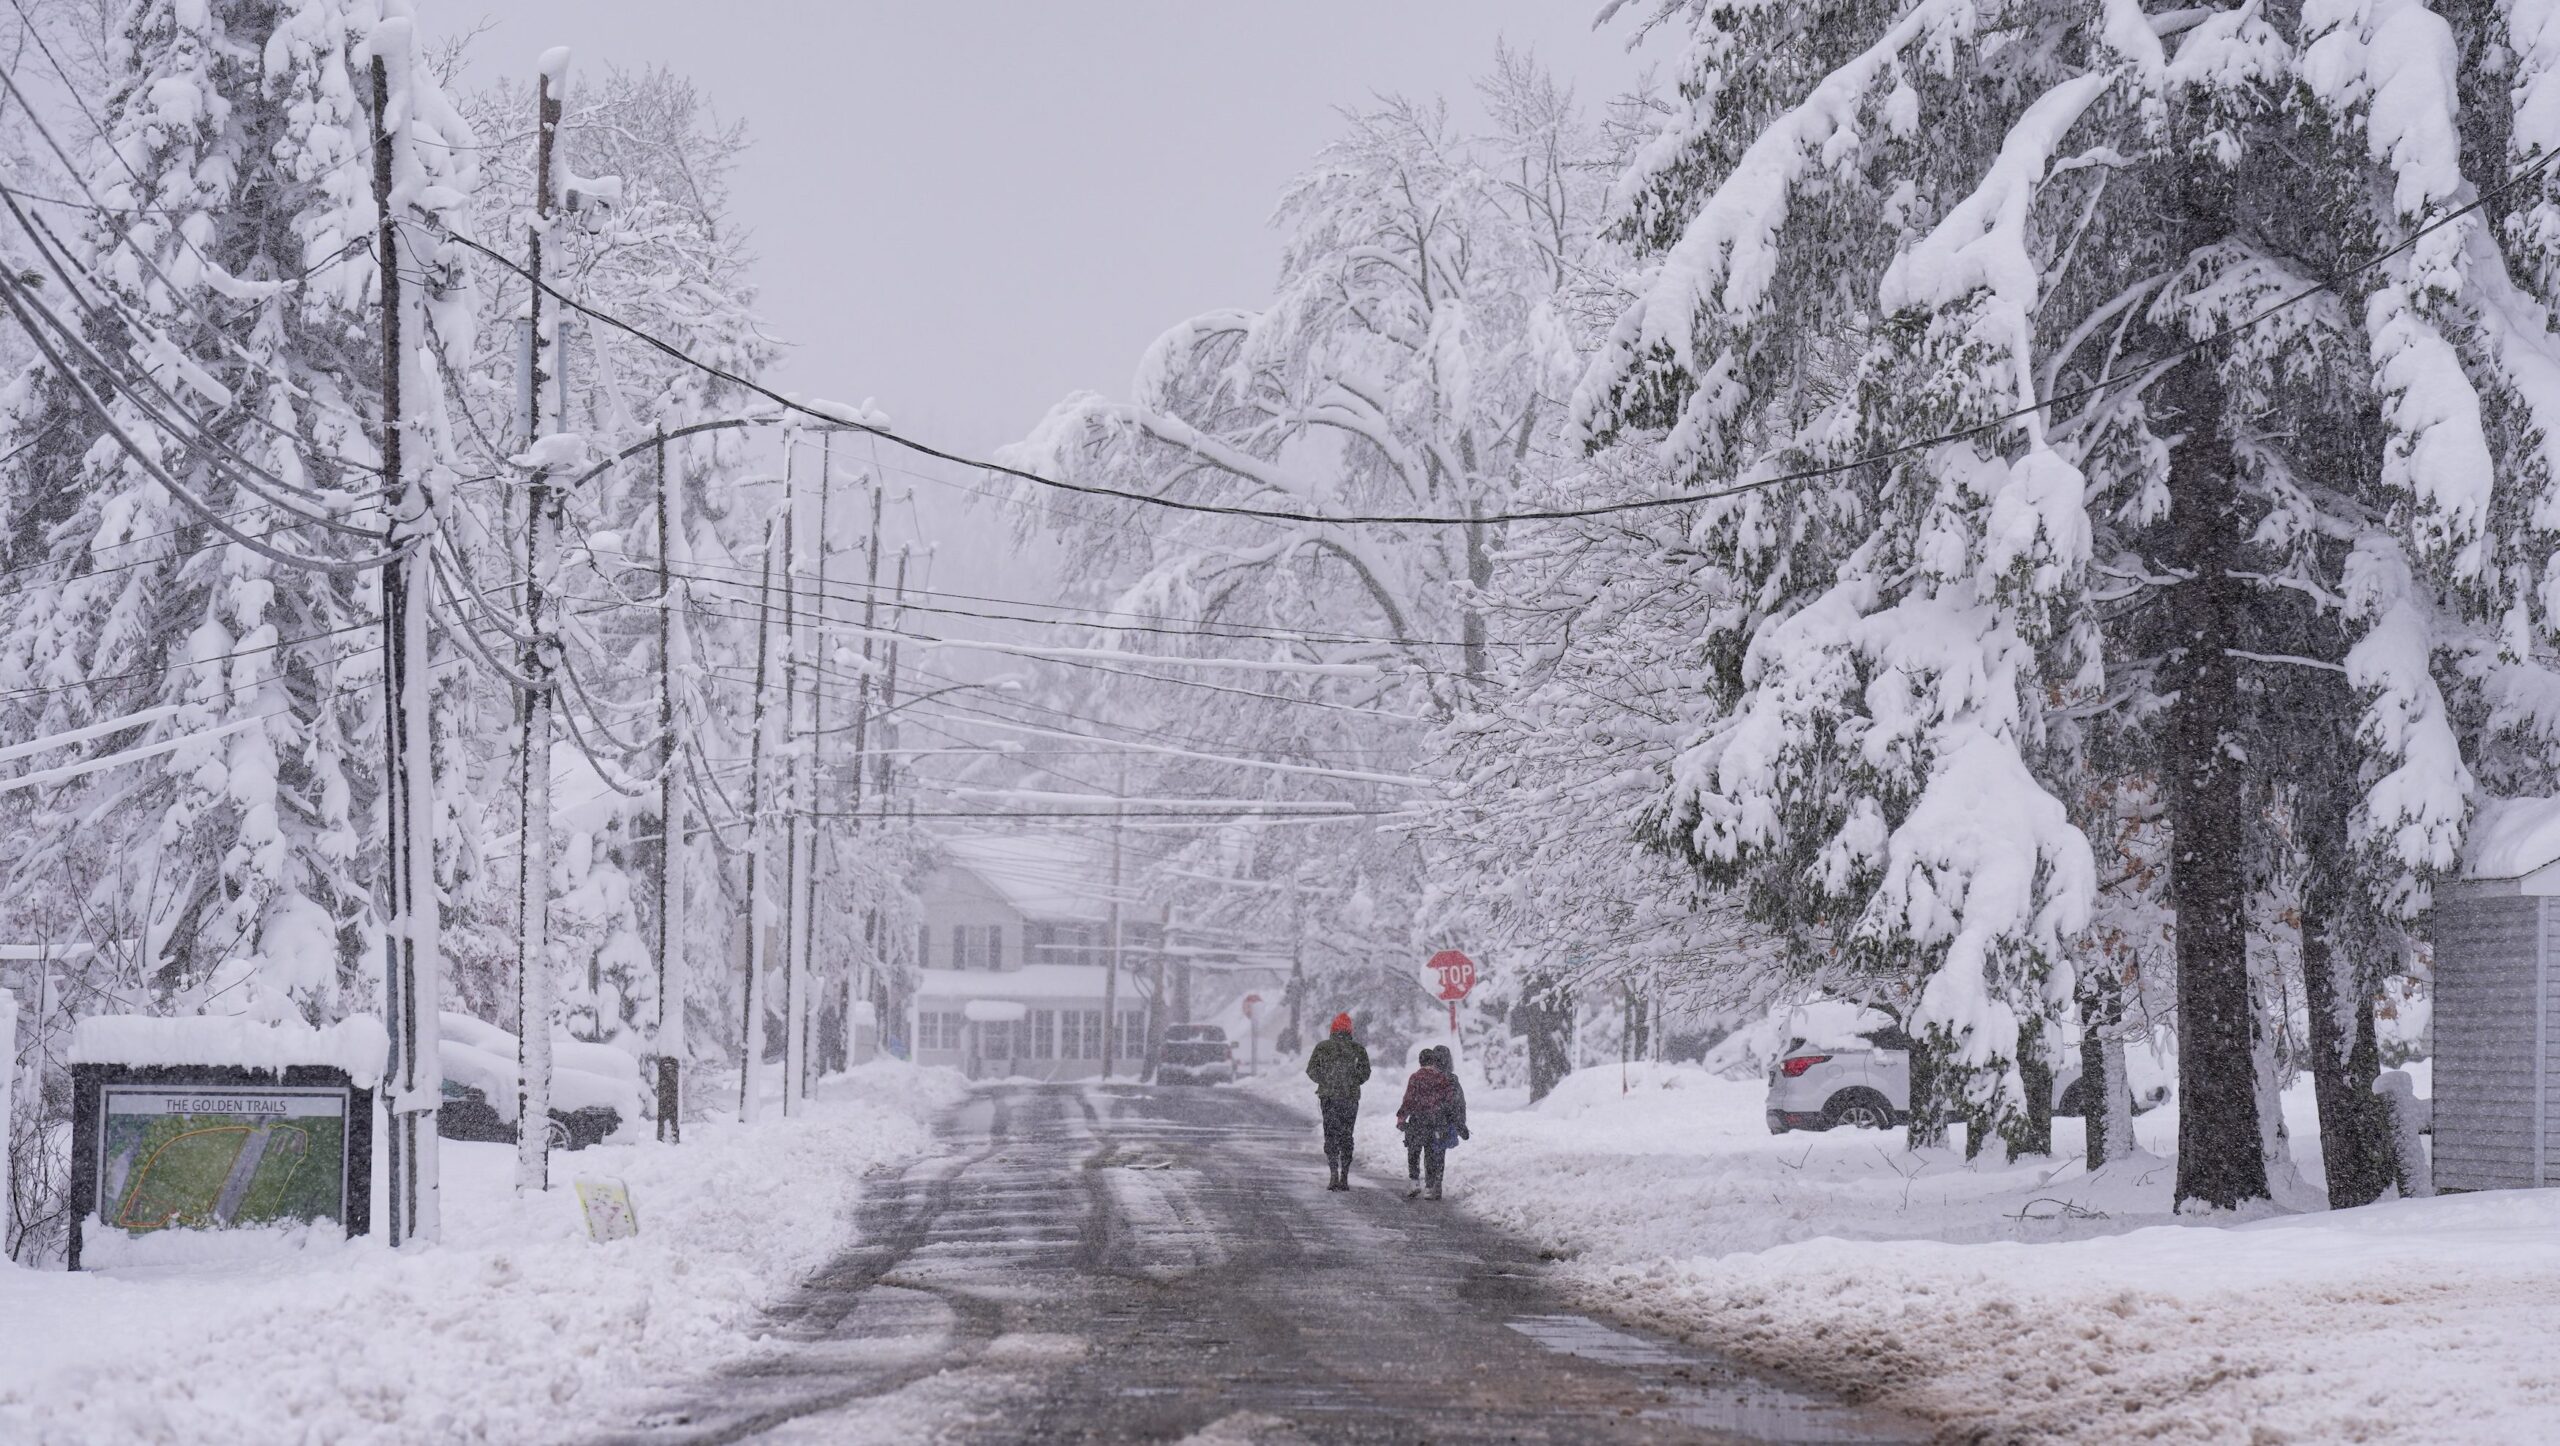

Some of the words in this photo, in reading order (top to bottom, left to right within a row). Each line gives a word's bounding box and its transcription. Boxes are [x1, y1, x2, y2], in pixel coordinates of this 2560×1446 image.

[1436, 964, 1473, 985] TOP
[166, 1099, 189, 1111] THE
[192, 1099, 243, 1112] GOLDEN
[246, 1100, 287, 1112] TRAILS
